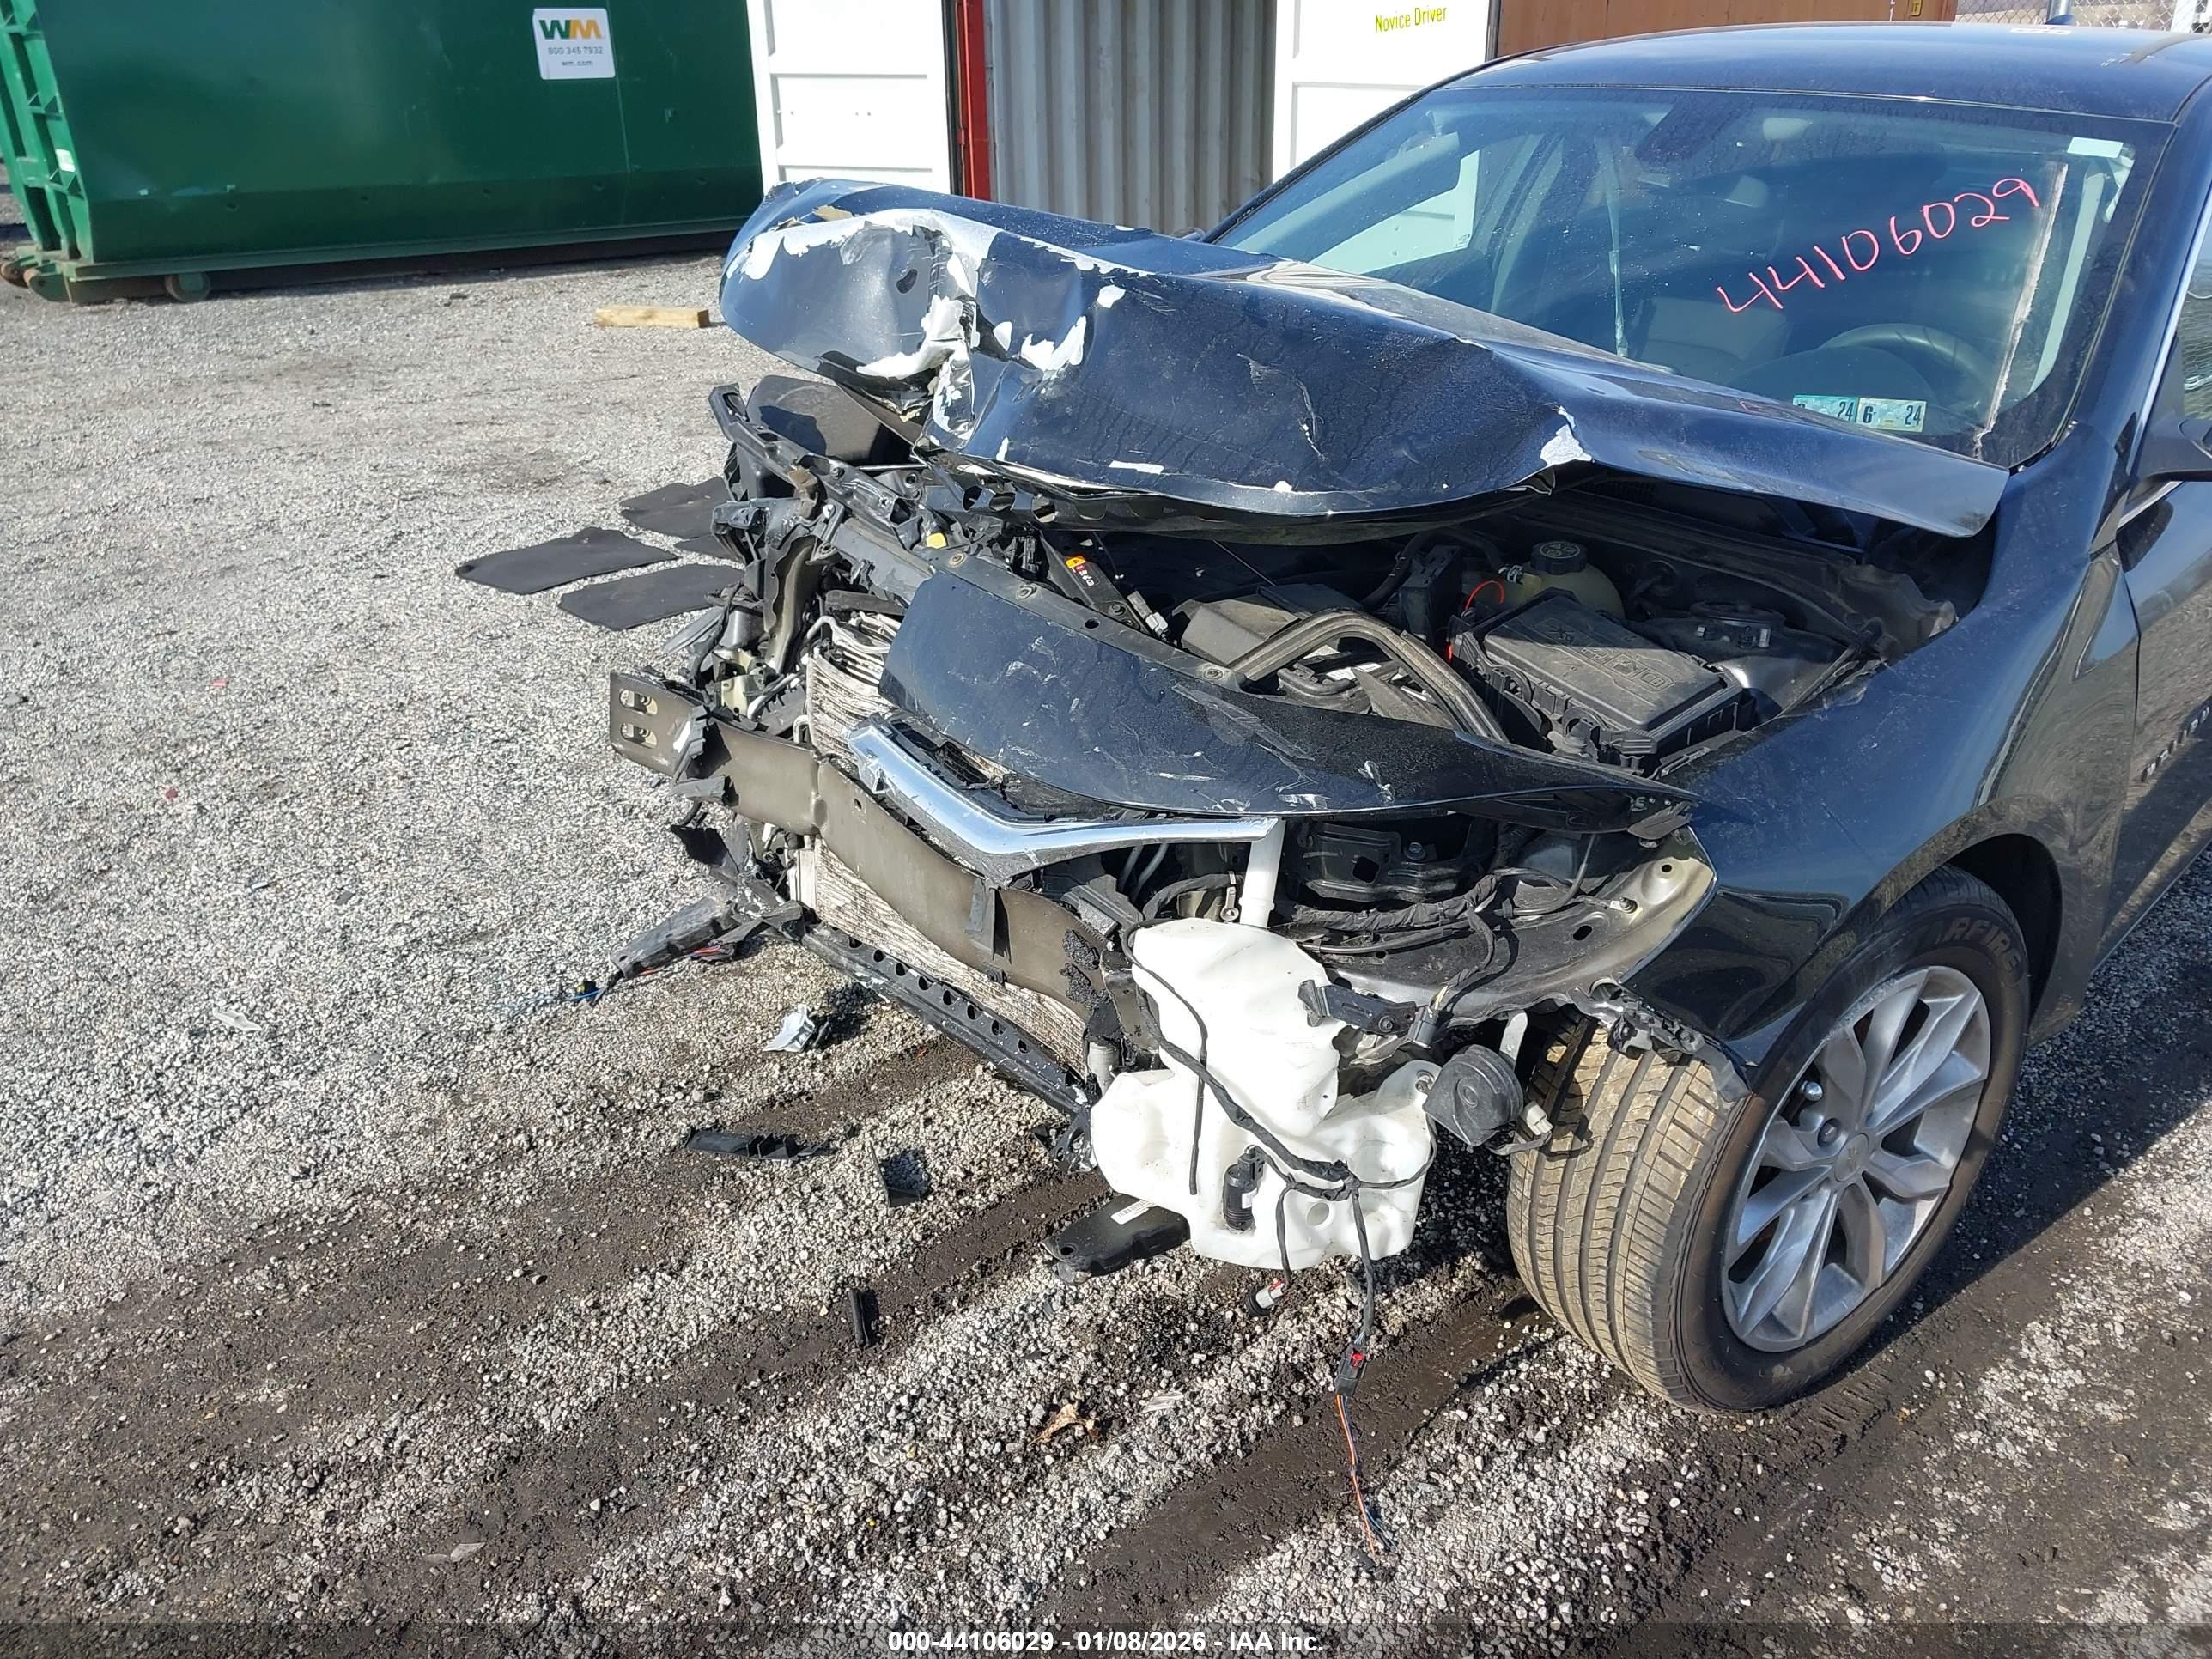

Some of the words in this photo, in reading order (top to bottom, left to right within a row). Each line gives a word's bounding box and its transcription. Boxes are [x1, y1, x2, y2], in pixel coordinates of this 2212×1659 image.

[538, 19, 603, 40] WM
[1376, 14, 1411, 33] Novice
[1414, 6, 1447, 26] Driver
[1717, 177, 2039, 313] 44106029
[1838, 401, 1855, 422] 24
[1863, 405, 1874, 424] 6
[1905, 404, 1923, 427] 24
